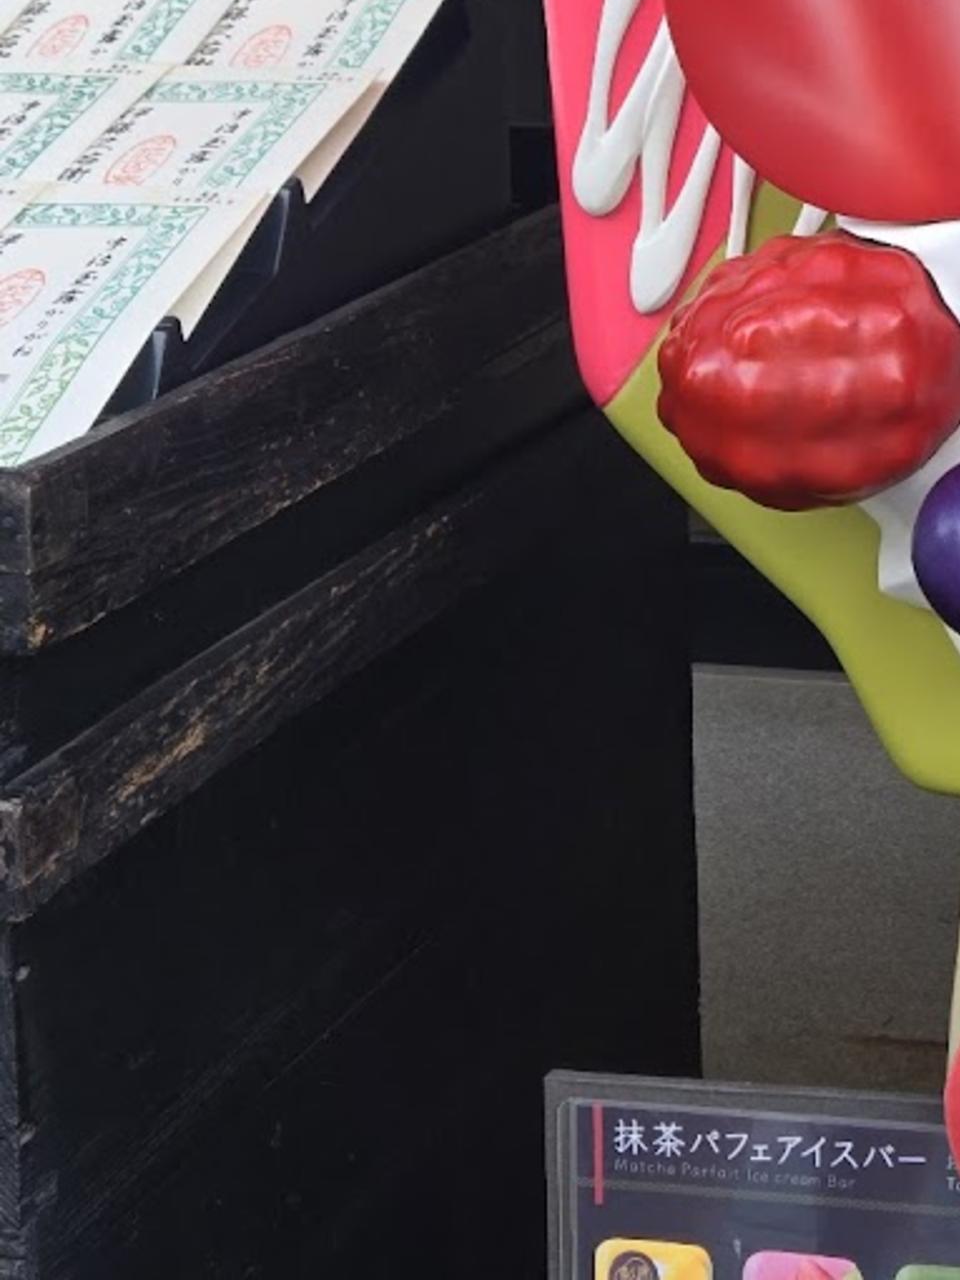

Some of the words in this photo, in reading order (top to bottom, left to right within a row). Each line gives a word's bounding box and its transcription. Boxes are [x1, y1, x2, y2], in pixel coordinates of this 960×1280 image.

[613, 1118, 927, 1169] 抹茶パフェアイスバー
[828, 1174, 857, 1189] Bar
